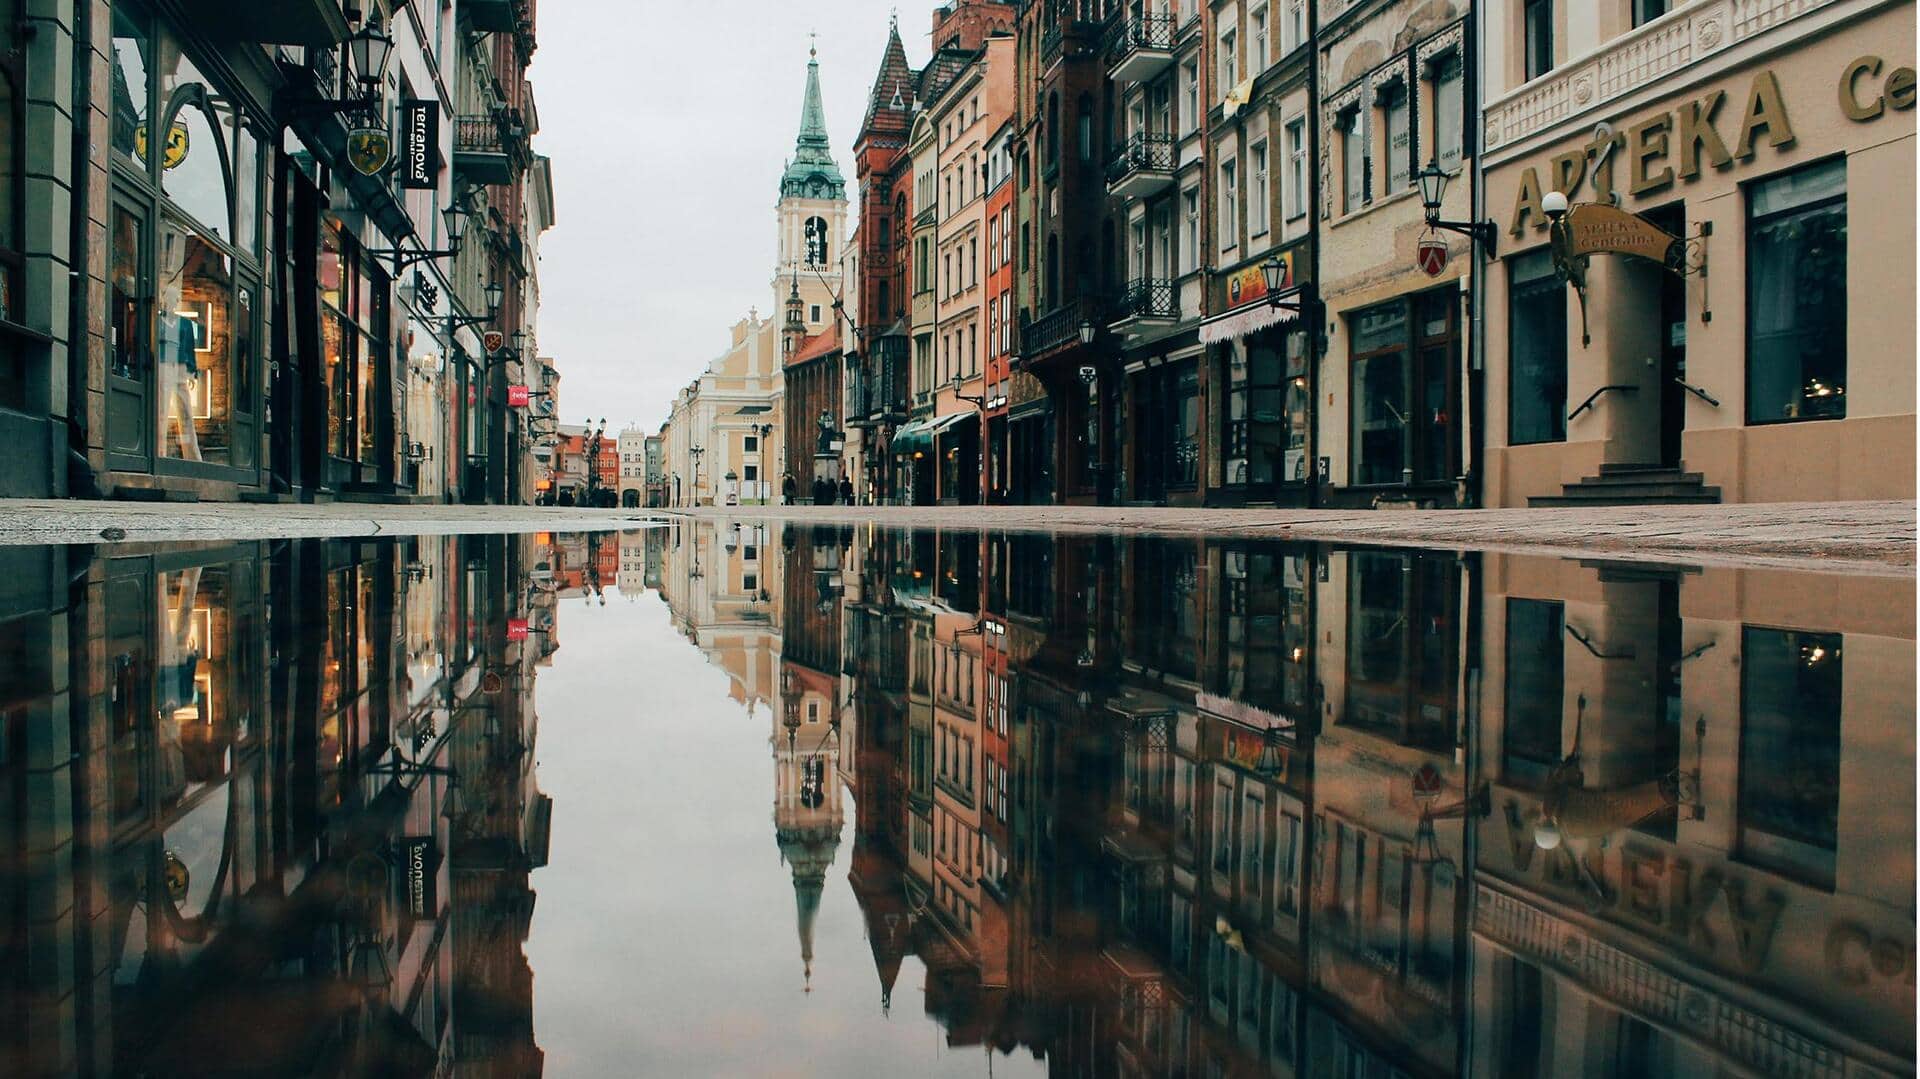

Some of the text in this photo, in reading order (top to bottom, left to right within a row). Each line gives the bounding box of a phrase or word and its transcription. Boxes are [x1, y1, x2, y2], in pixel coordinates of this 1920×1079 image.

[1510, 69, 1796, 236] APTEKA
[1581, 220, 1640, 235] APTEKA
[1580, 234, 1656, 249] Centralna
